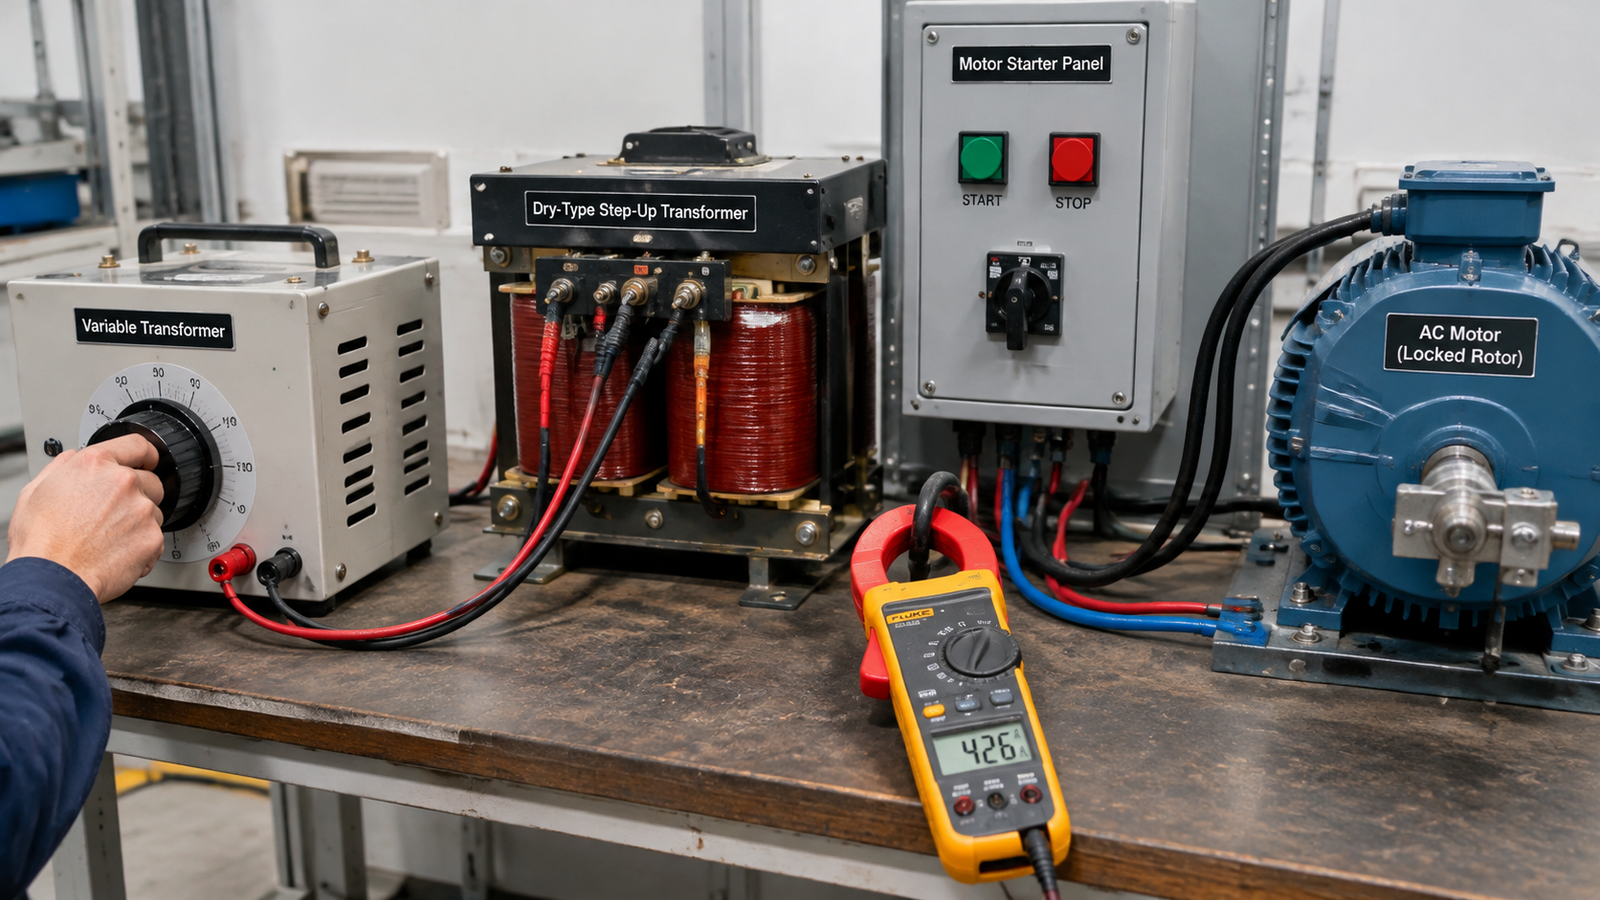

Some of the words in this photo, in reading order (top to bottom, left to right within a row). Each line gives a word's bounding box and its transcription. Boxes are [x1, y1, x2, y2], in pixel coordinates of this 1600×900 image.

[959, 56, 1003, 71] Motor
[1007, 56, 1058, 71] Starter
[1062, 56, 1104, 71] Panel
[962, 194, 1002, 207] START
[1055, 197, 1092, 209] STOP
[533, 201, 595, 219] Dry-Type
[599, 203, 657, 221] Step-Up
[660, 204, 748, 220] Transformer
[82, 318, 137, 334] Variable
[140, 320, 226, 338] Transformer
[1419, 325, 1445, 340] AC
[1450, 325, 1502, 342] Motor
[1397, 345, 1466, 364] (Locked
[1471, 348, 1523, 368] Rotor)
[892, 610, 930, 621] FLUKE
[961, 731, 1016, 765] 426
